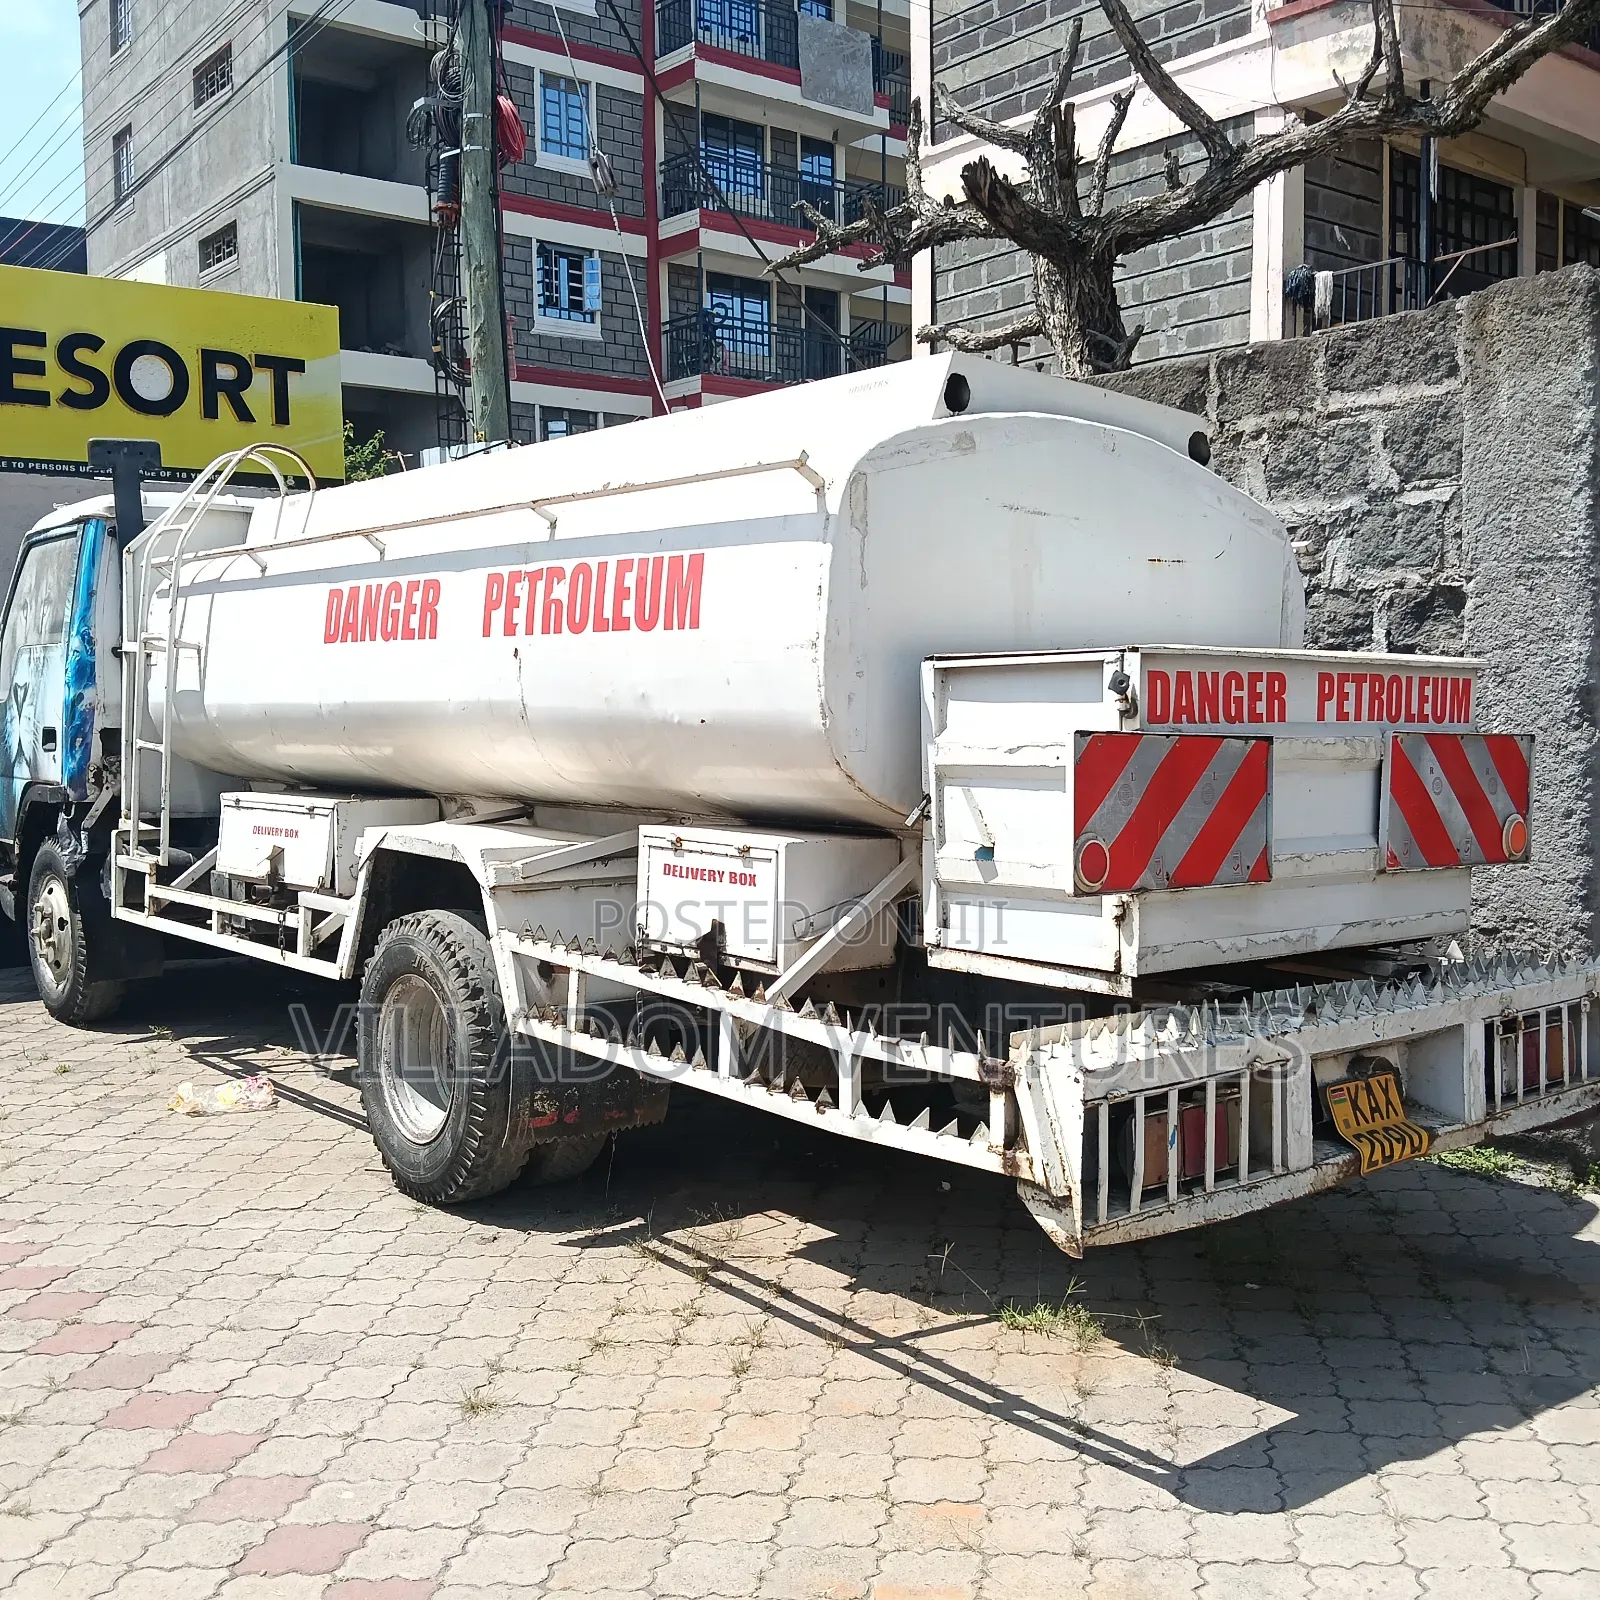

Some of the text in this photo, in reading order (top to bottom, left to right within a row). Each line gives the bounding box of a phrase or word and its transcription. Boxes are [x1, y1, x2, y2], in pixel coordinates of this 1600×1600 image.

[0, 327, 305, 426] ESORT
[0, 460, 7, 468] E
[12, 461, 24, 469] TO
[29, 462, 76, 472] PERSONS
[160, 470, 172, 478] OF
[324, 553, 705, 644] DANGER PETROLEUM
[1147, 669, 1472, 725] DANGER PETROLEUM
[1429, 766, 1434, 774] R
[253, 825, 299, 838] DELIVERY BOX
[663, 863, 757, 887] DELIVERY BOX
[1345, 1077, 1399, 1127] KAX
